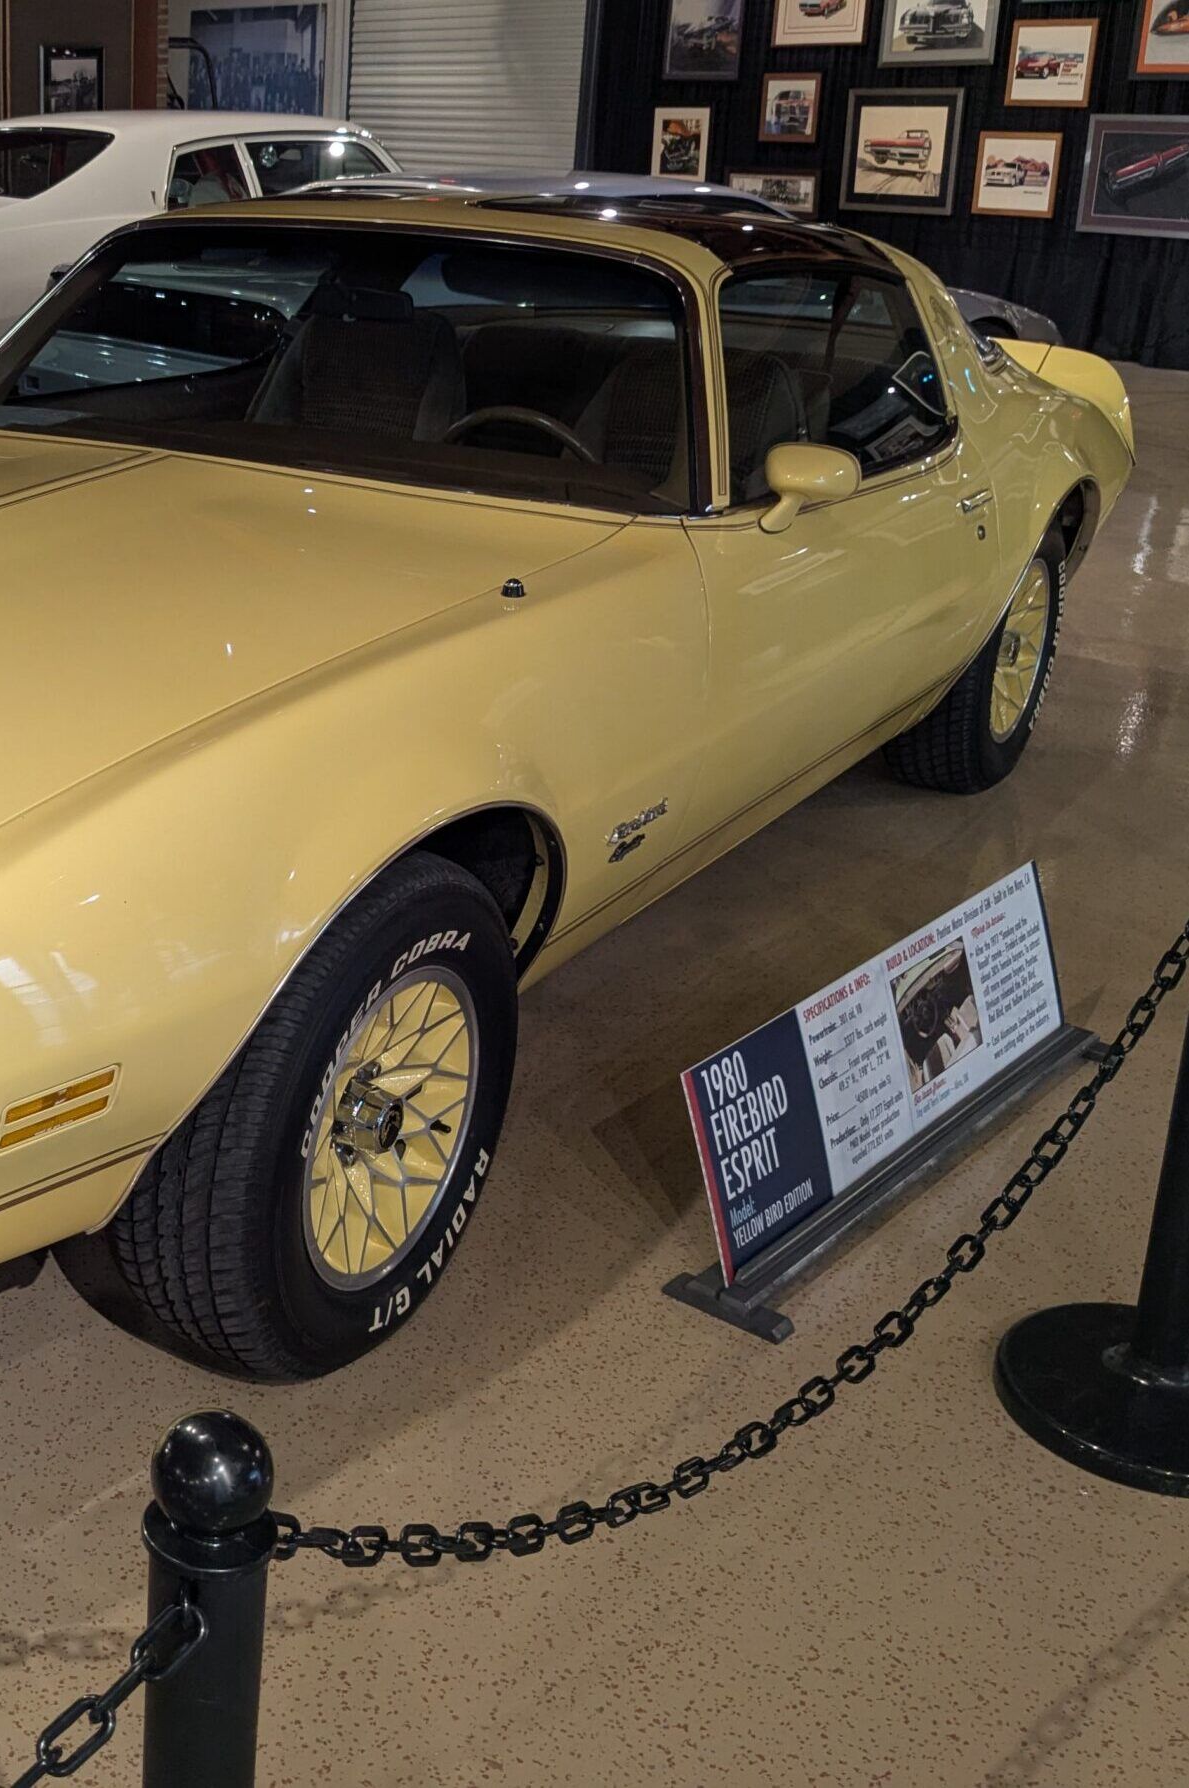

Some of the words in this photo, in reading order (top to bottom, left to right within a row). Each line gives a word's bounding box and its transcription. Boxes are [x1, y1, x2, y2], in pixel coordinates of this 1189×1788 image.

[885, 954, 902, 972] BUILD
[903, 950, 908, 961] &
[908, 930, 936, 958] LOCATION:
[803, 986, 849, 1023] SPECIFICATIONS
[848, 983, 854, 994] &
[854, 973, 871, 991] INFO:
[301, 980, 382, 1158] COOPER
[390, 930, 472, 980] COBRA
[701, 1050, 749, 1111] 1980
[710, 1074, 789, 1156] FIREBIRD
[720, 1126, 780, 1201] ESPRIT
[416, 1148, 490, 1284] RADIAL
[729, 1195, 757, 1229] Model:
[732, 1212, 765, 1249] YELLOW
[764, 1199, 784, 1228] BIRD
[784, 1178, 814, 1215] EDITION
[368, 1286, 410, 1333] G/T
